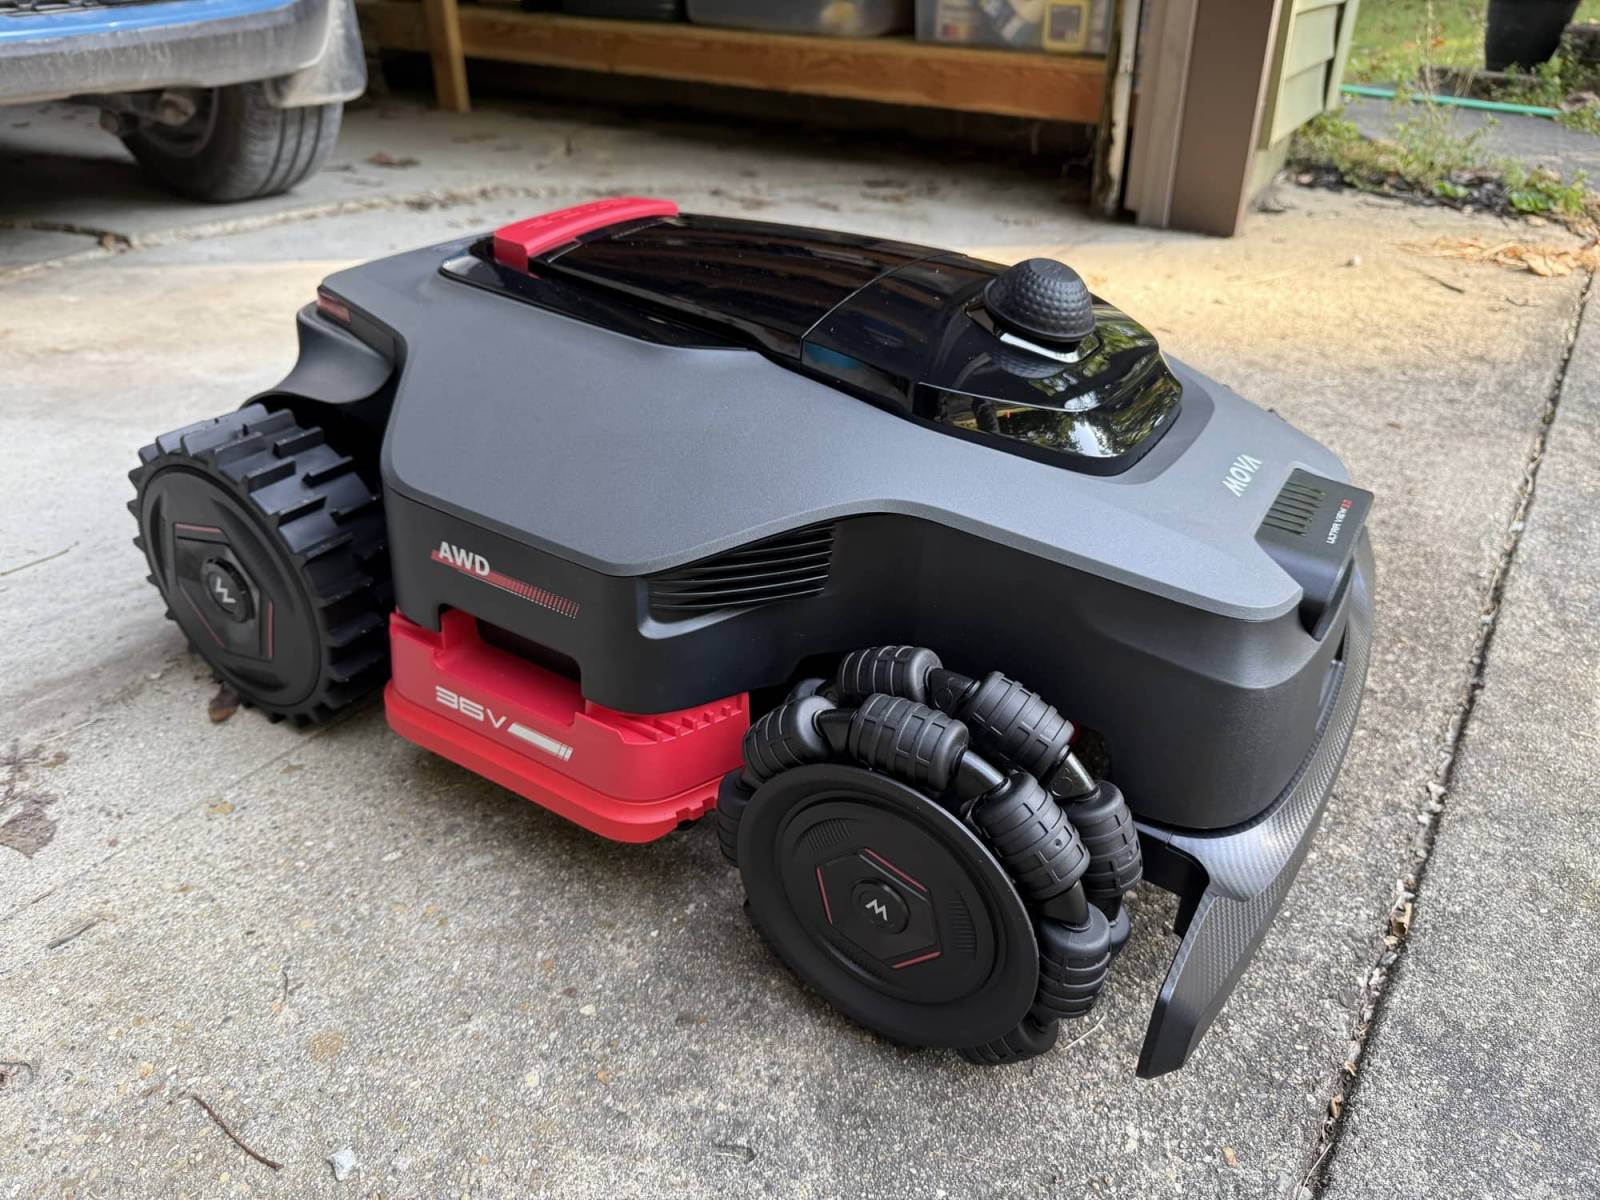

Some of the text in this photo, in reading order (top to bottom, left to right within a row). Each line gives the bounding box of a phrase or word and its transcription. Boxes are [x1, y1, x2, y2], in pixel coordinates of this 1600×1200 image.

[1222, 454, 1262, 497] MOVA
[1326, 522, 1342, 544] ULTRA
[438, 541, 490, 576] AWD
